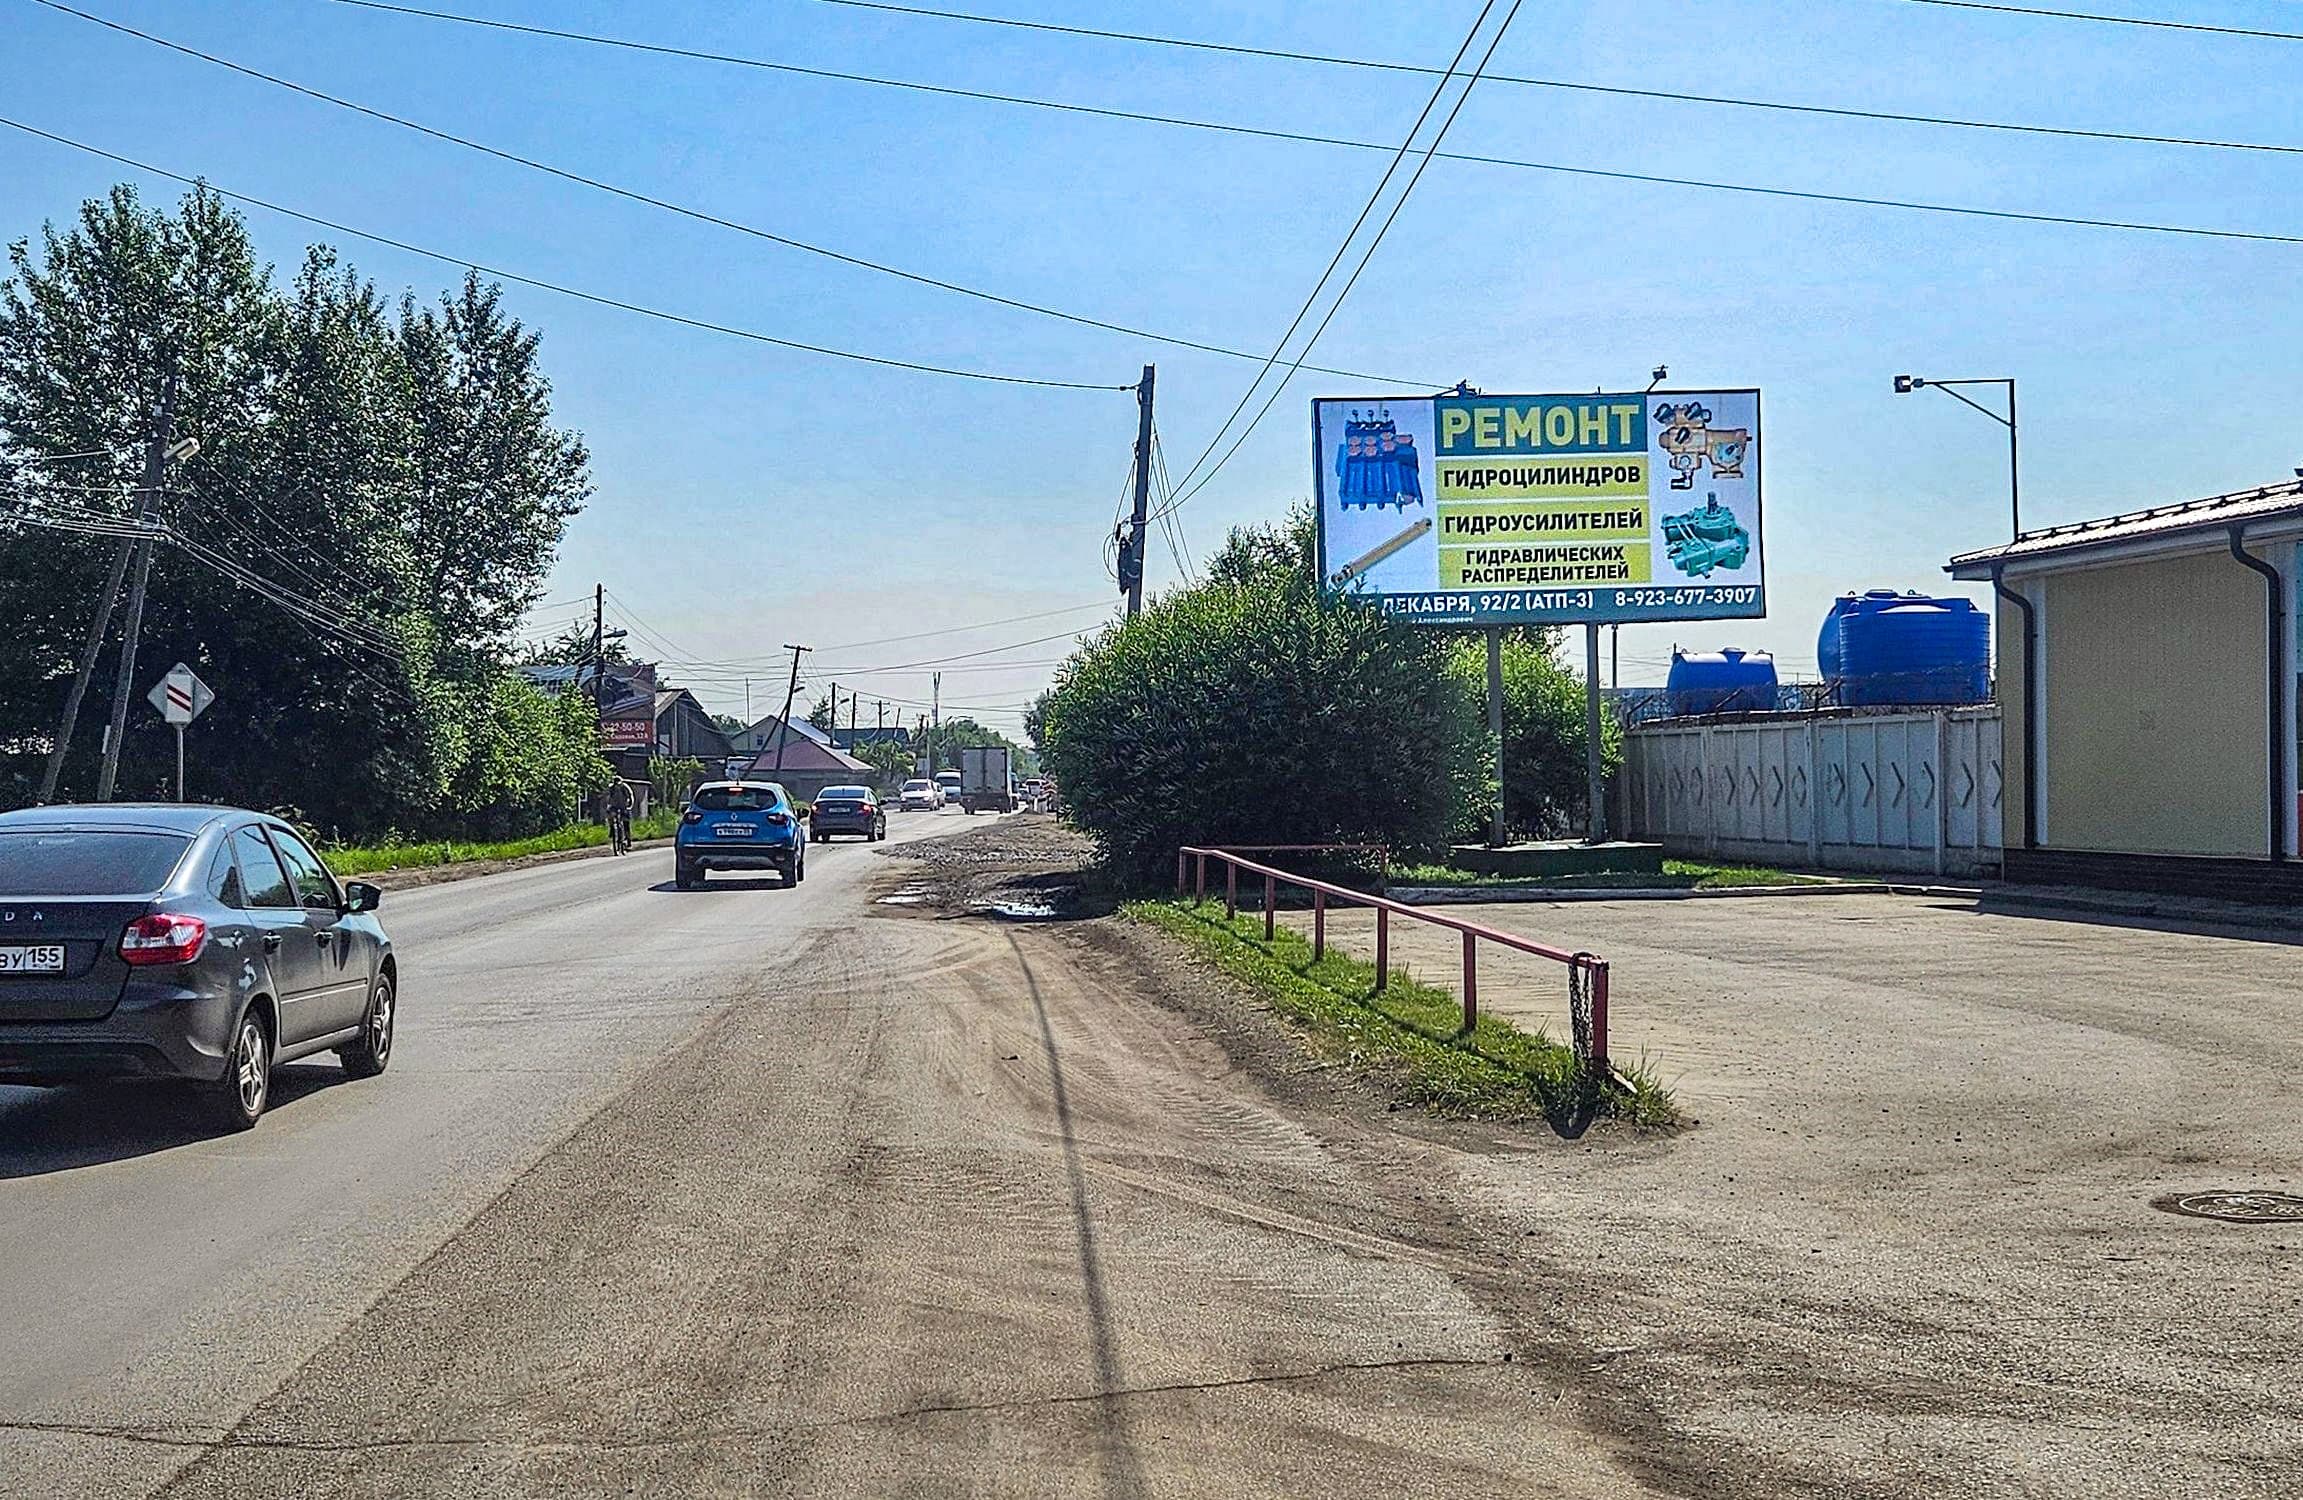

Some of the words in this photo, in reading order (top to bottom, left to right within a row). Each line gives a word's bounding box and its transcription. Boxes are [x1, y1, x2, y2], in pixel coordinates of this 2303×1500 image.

[1442, 405, 1640, 449] РЕМОНТ
[1444, 466, 1641, 490] ГИДРОЦИЛИНДРОВ
[1445, 507, 1643, 535] ГИДРОУСИЛИТЕЛЕЙ
[1466, 546, 1625, 567] ГИДРАВЛИЧЕСКИХ
[1462, 561, 1629, 584] РАСПРЕДЕЛИТЕЛЕЙ
[1480, 593, 1521, 611] 92/2
[1525, 590, 1594, 611] (АТП-3)
[1615, 587, 1756, 606] 8-923-677-3907
